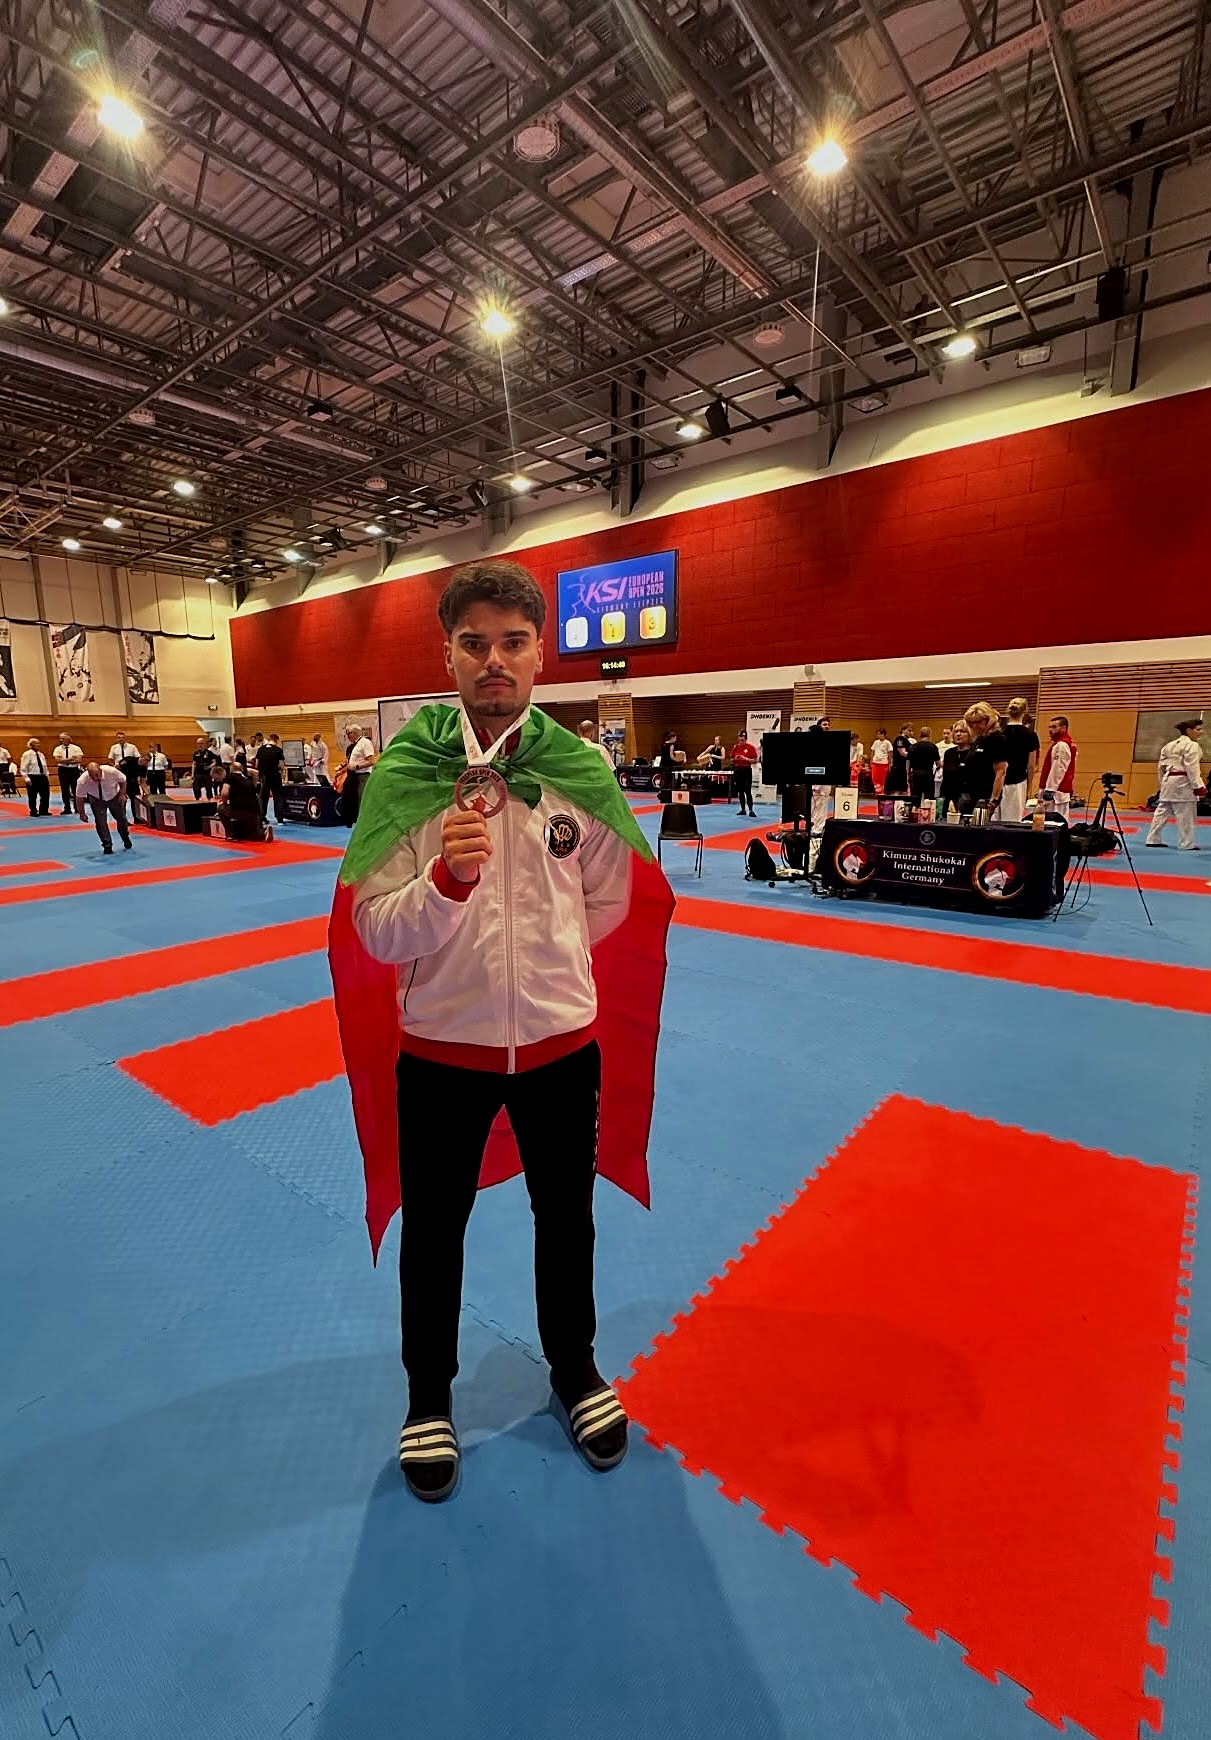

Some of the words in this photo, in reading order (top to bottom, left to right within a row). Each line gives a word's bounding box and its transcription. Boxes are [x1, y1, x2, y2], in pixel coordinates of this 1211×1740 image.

[628, 571, 664, 587] EUROPEAN
[586, 576, 628, 605] KSI
[628, 585, 645, 599] OPEN
[842, 800, 851, 812] 6
[882, 849, 918, 861] Kimura
[919, 853, 967, 867] Shukokai
[893, 861, 955, 875] International
[901, 871, 945, 886] Germany
